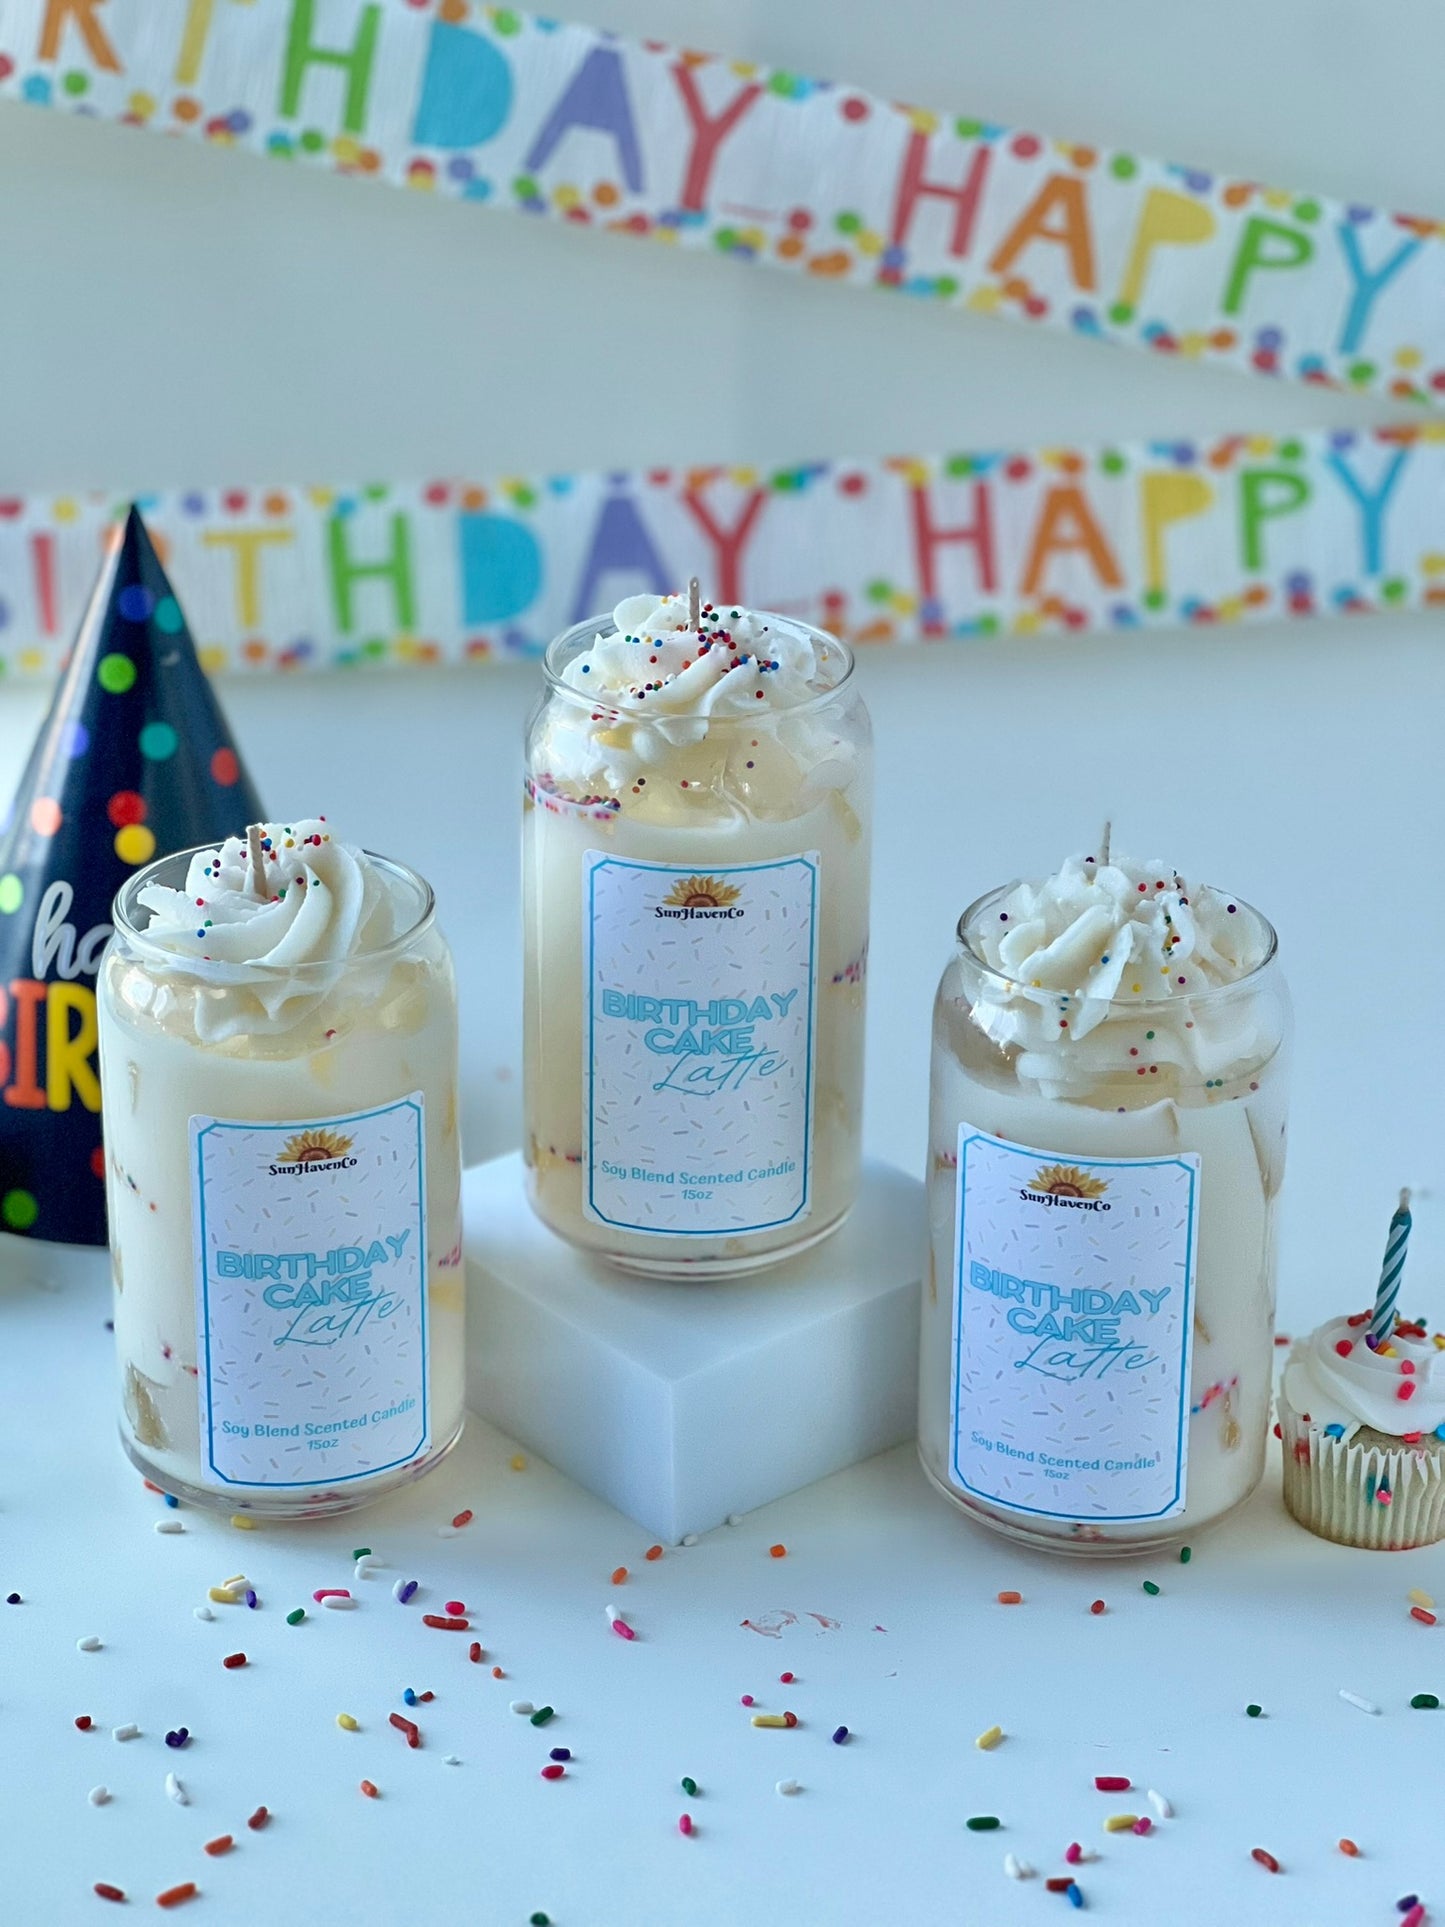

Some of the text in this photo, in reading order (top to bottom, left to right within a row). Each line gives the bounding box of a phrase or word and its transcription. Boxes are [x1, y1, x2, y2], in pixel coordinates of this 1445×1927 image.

[888, 130, 1425, 357] HAPPY
[30, 448, 1411, 640] ITHDAY HAPPY
[602, 988, 798, 1027] BIRTHDAY
[644, 1025, 755, 1056] CAKE
[652, 1046, 788, 1096] Latte
[601, 1160, 796, 1186] Soy Blend Scented Candle
[681, 1188, 713, 1201] 15oz
[216, 1228, 411, 1280] BIRTHDAY
[263, 1271, 372, 1309] CAKE
[969, 1260, 1171, 1316] BIRTHDAY
[273, 1290, 405, 1346] Latte
[1007, 1307, 1121, 1345] CAKE
[1014, 1335, 1159, 1382] Latte
[222, 1397, 416, 1438] Soy Blend Scented Candle
[307, 1438, 339, 1451] 15oz
[970, 1431, 1155, 1471] Soy Blend Scented Candle
[1043, 1468, 1070, 1481] 15oz
